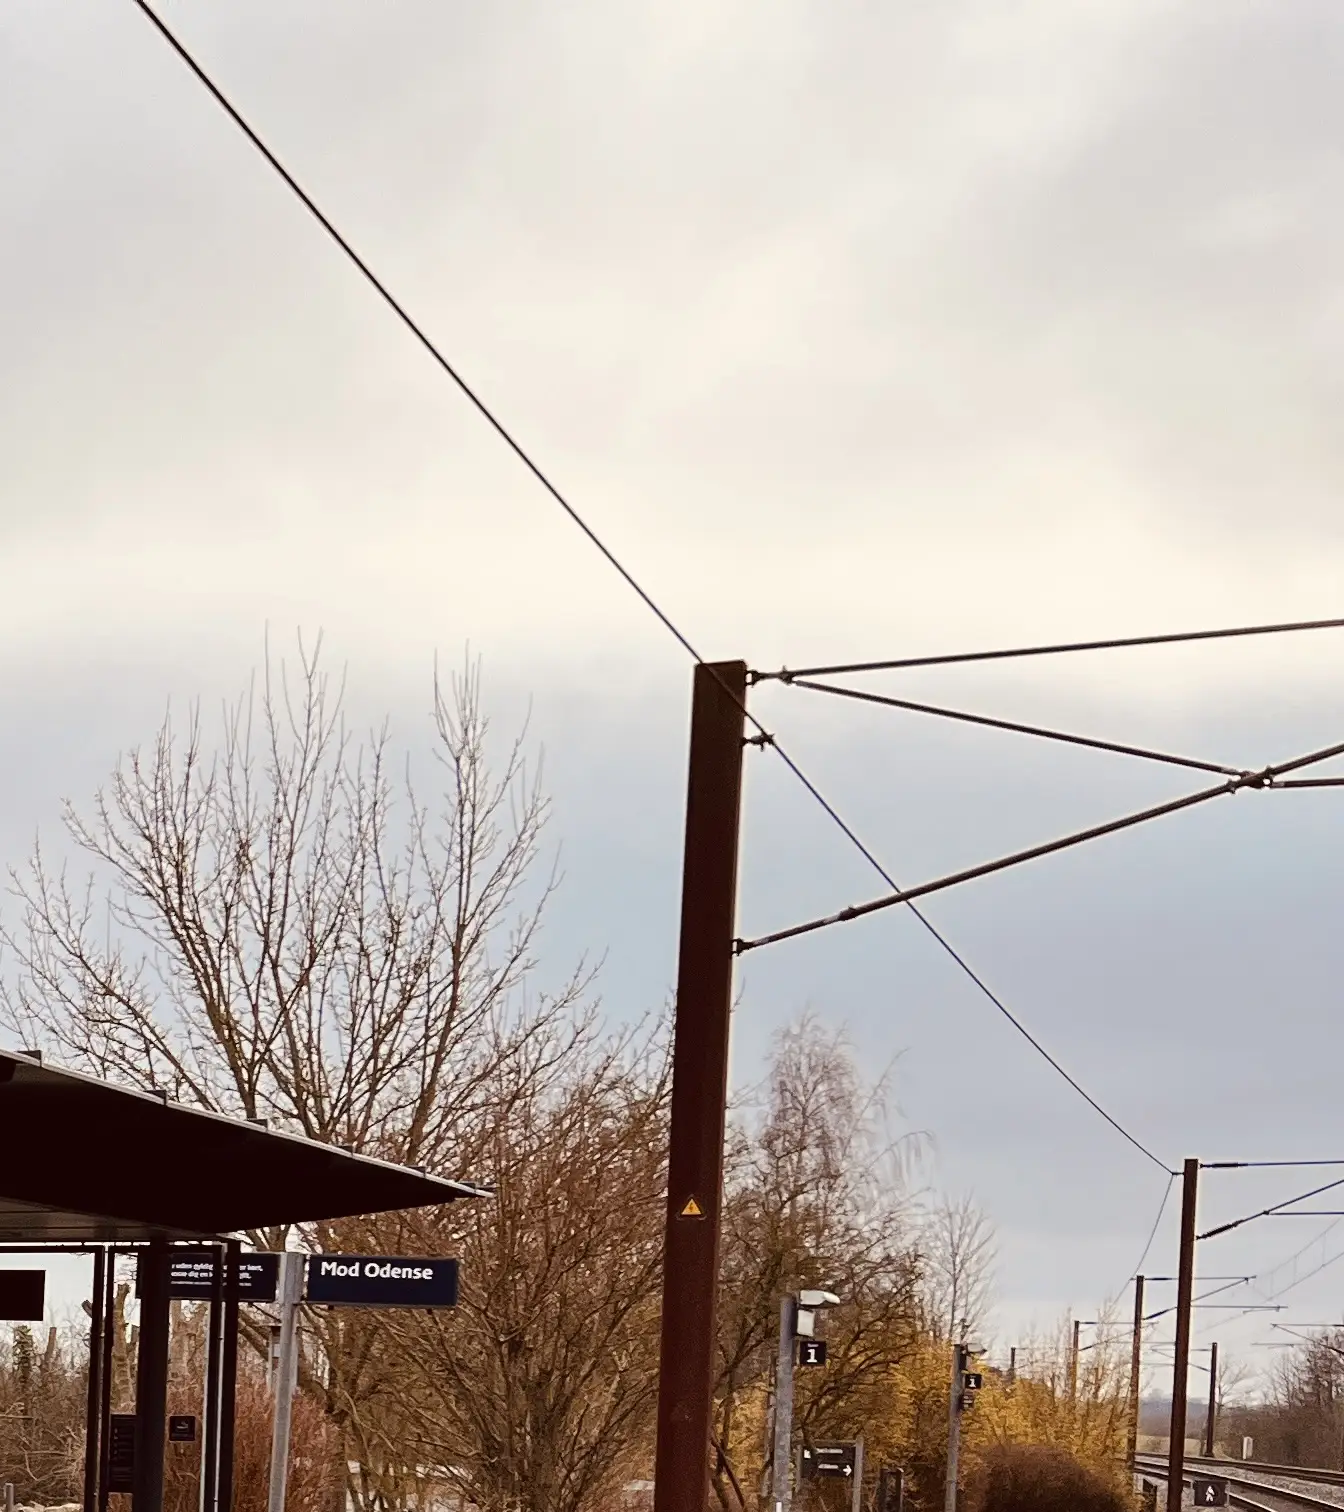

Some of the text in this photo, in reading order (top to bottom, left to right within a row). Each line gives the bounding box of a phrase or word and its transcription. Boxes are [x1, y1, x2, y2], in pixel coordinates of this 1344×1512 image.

[320, 1261, 433, 1280] Mod Odense
[806, 1348, 818, 1363] 1
